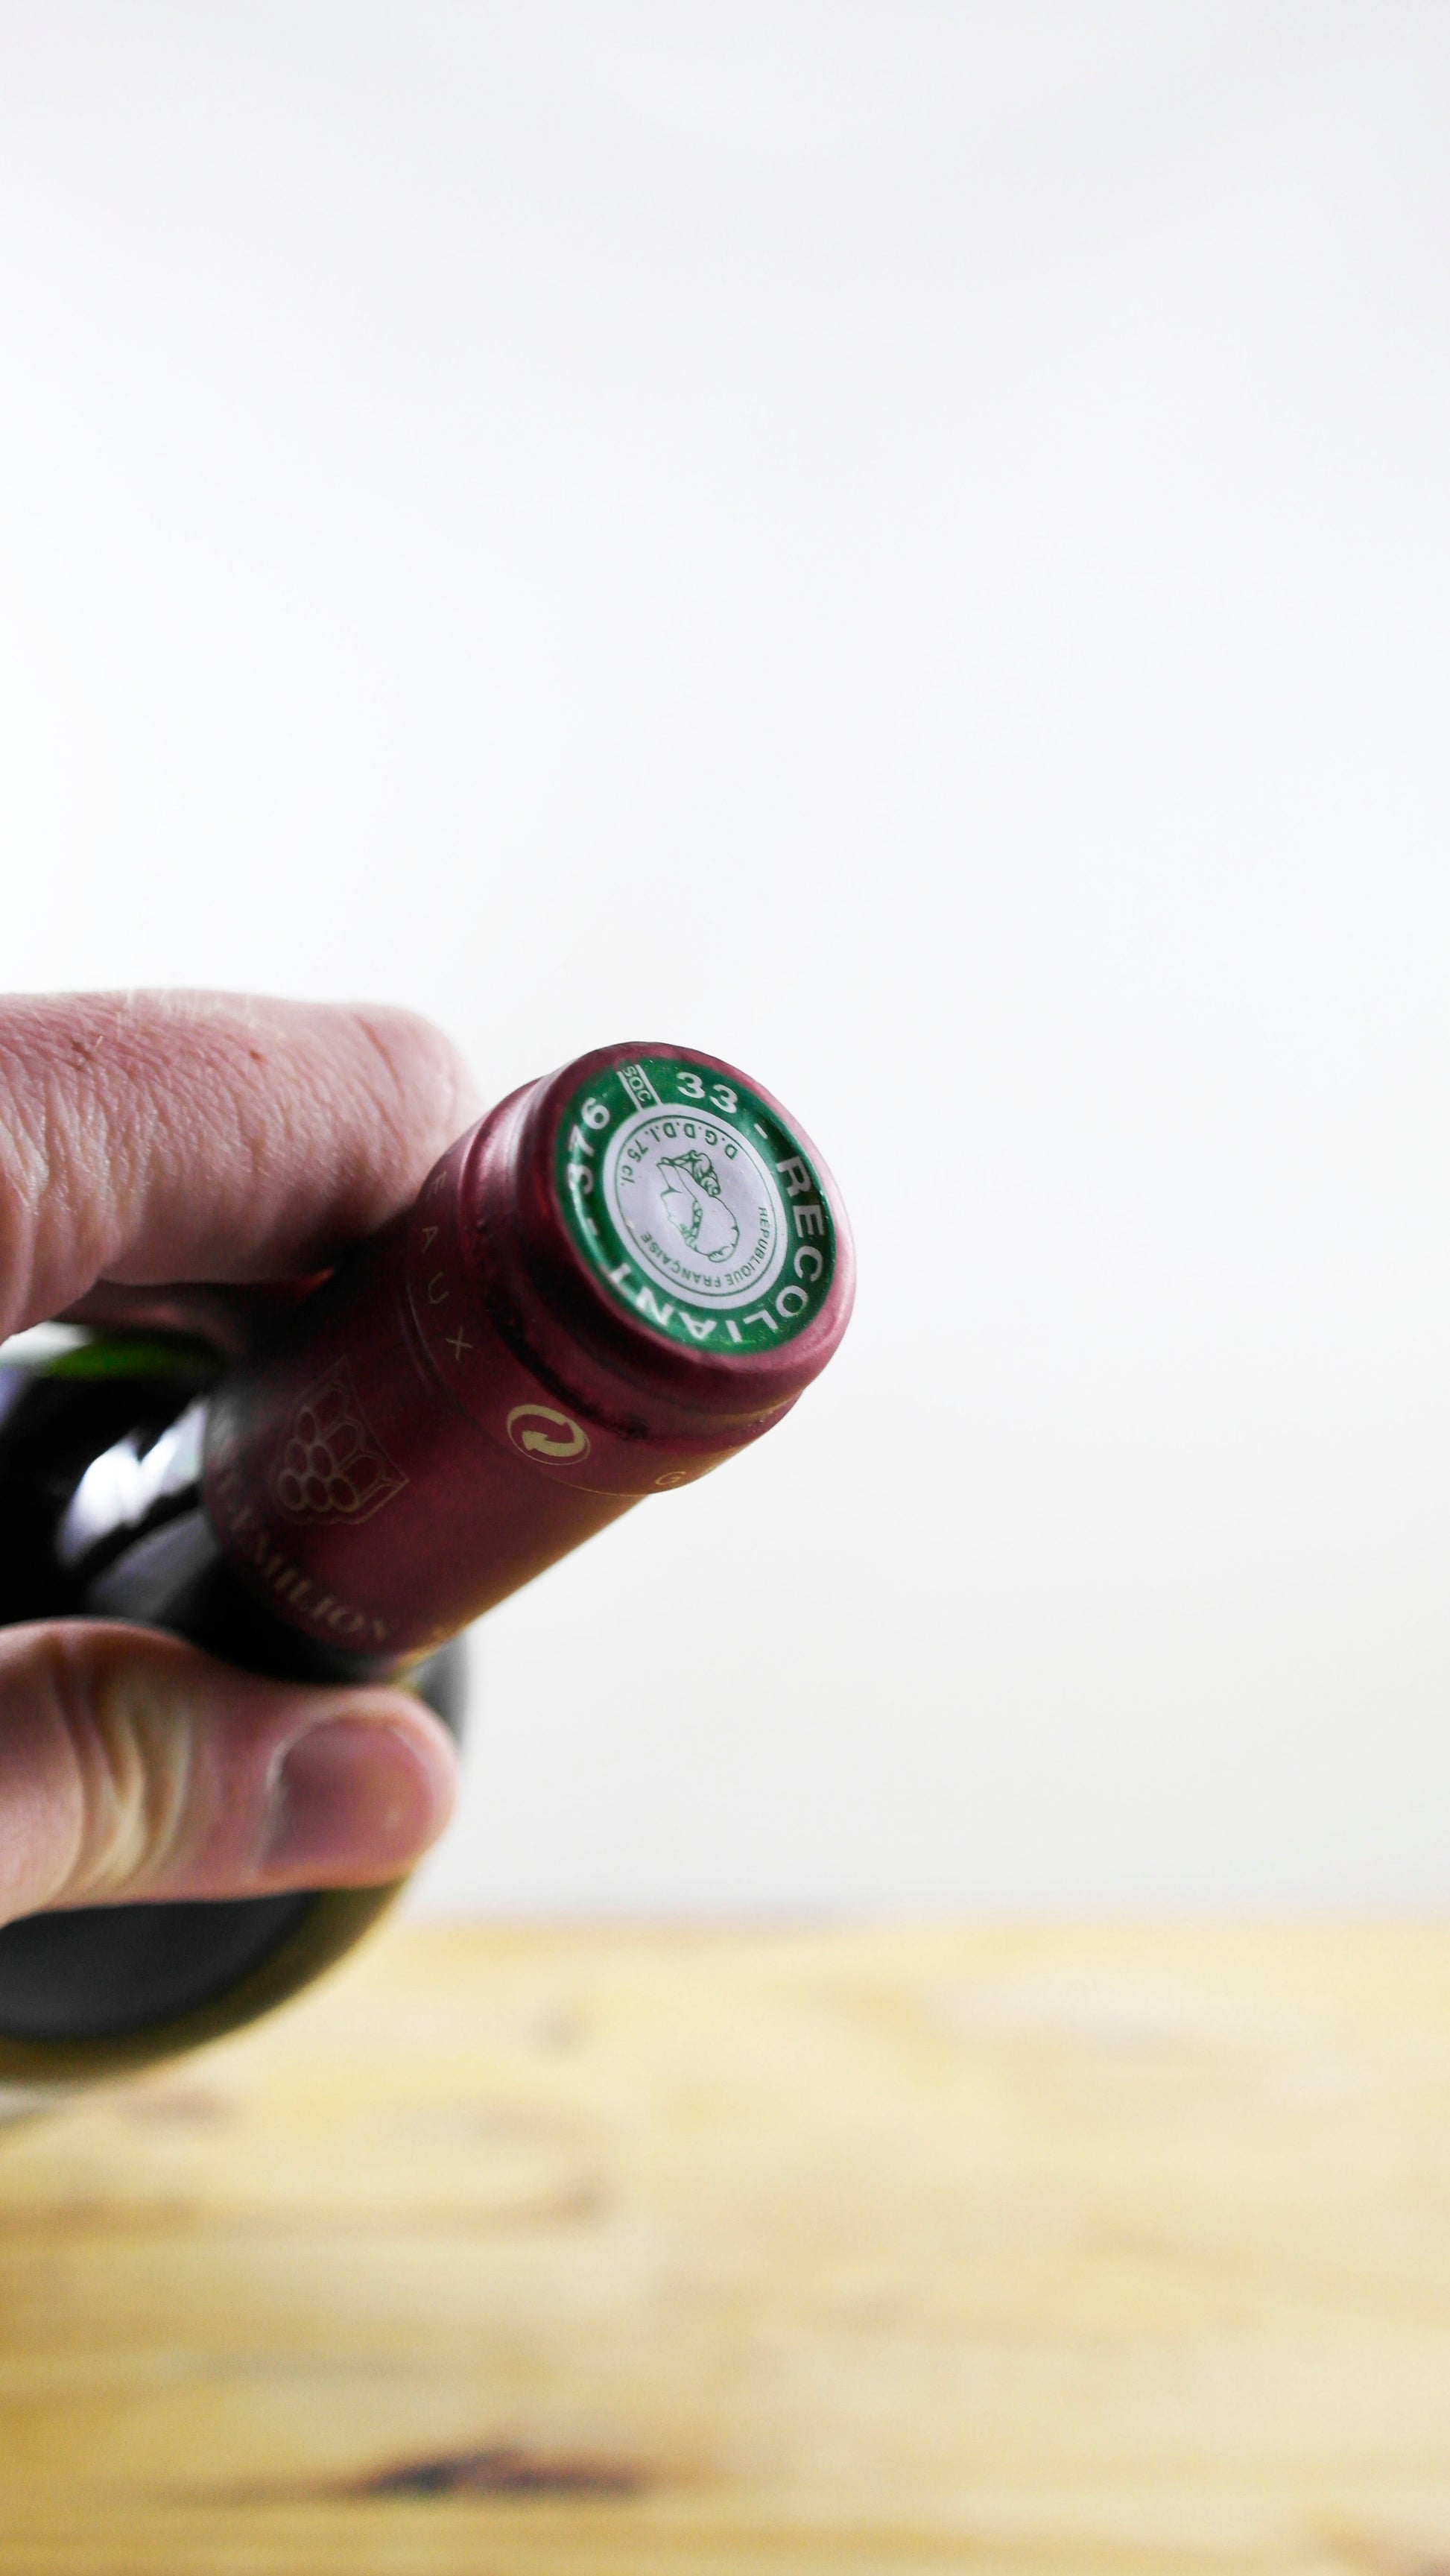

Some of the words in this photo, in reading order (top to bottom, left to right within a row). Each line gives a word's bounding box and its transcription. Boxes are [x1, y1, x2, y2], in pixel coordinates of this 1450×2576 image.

[676, 1072, 738, 1113] 33
[569, 1097, 610, 1194] 376
[627, 1139, 649, 1162] 75
